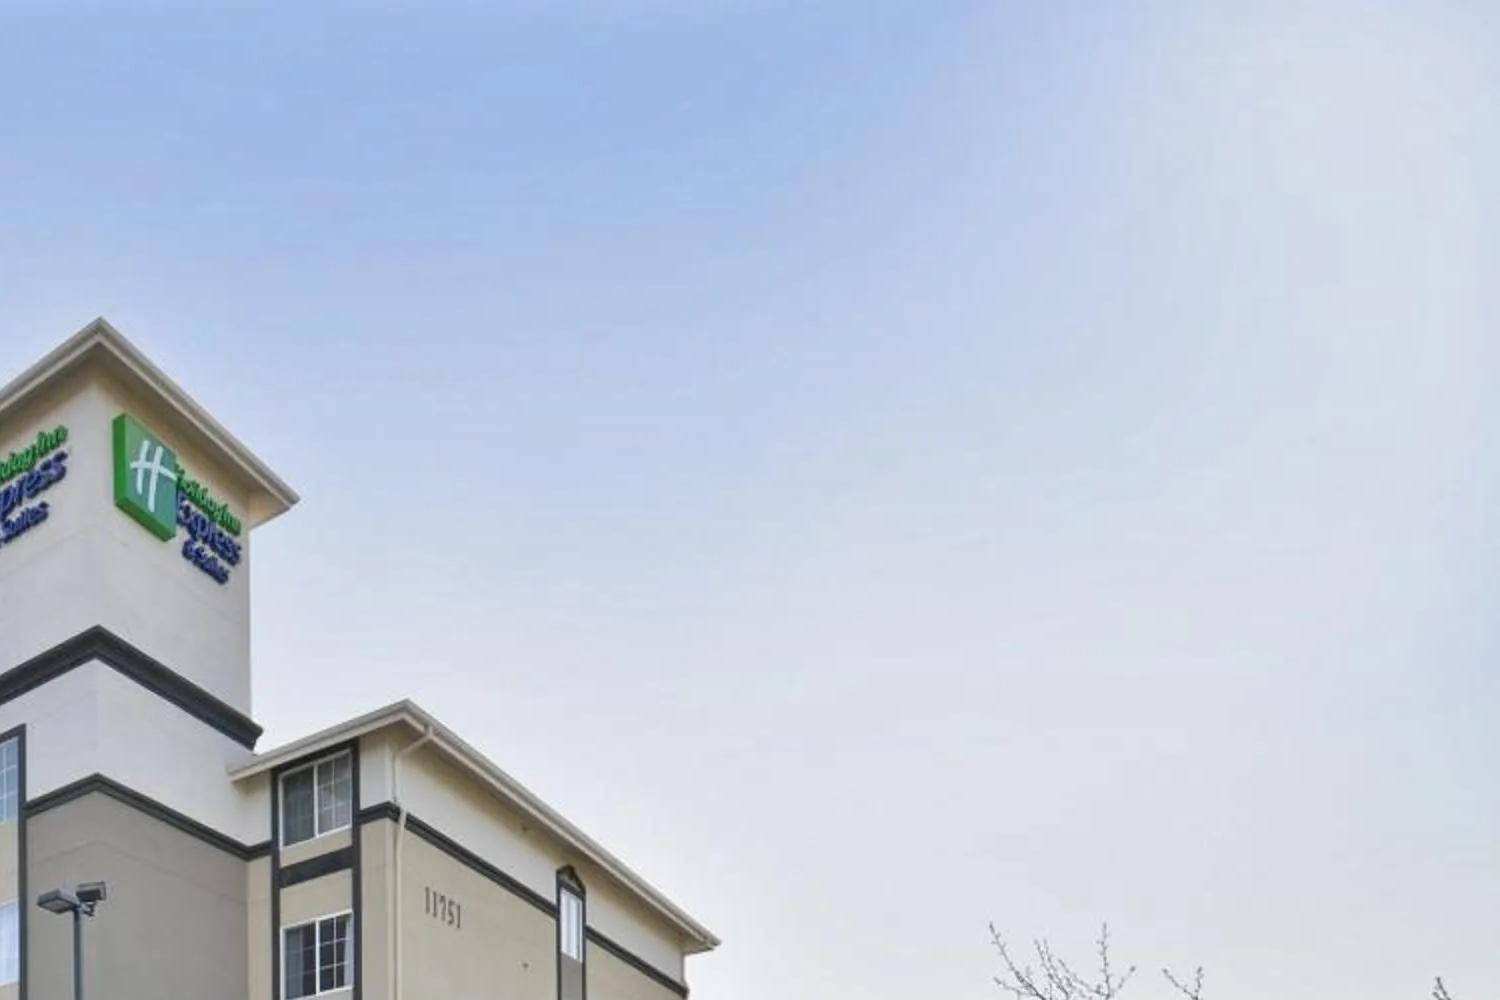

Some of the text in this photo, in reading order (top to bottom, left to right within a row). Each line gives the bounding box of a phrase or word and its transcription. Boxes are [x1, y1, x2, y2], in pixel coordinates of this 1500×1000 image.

[36, 424, 68, 458] Inn
[0, 501, 49, 544] Suites
[193, 546, 230, 585] Suites
[425, 886, 461, 929] 11751
